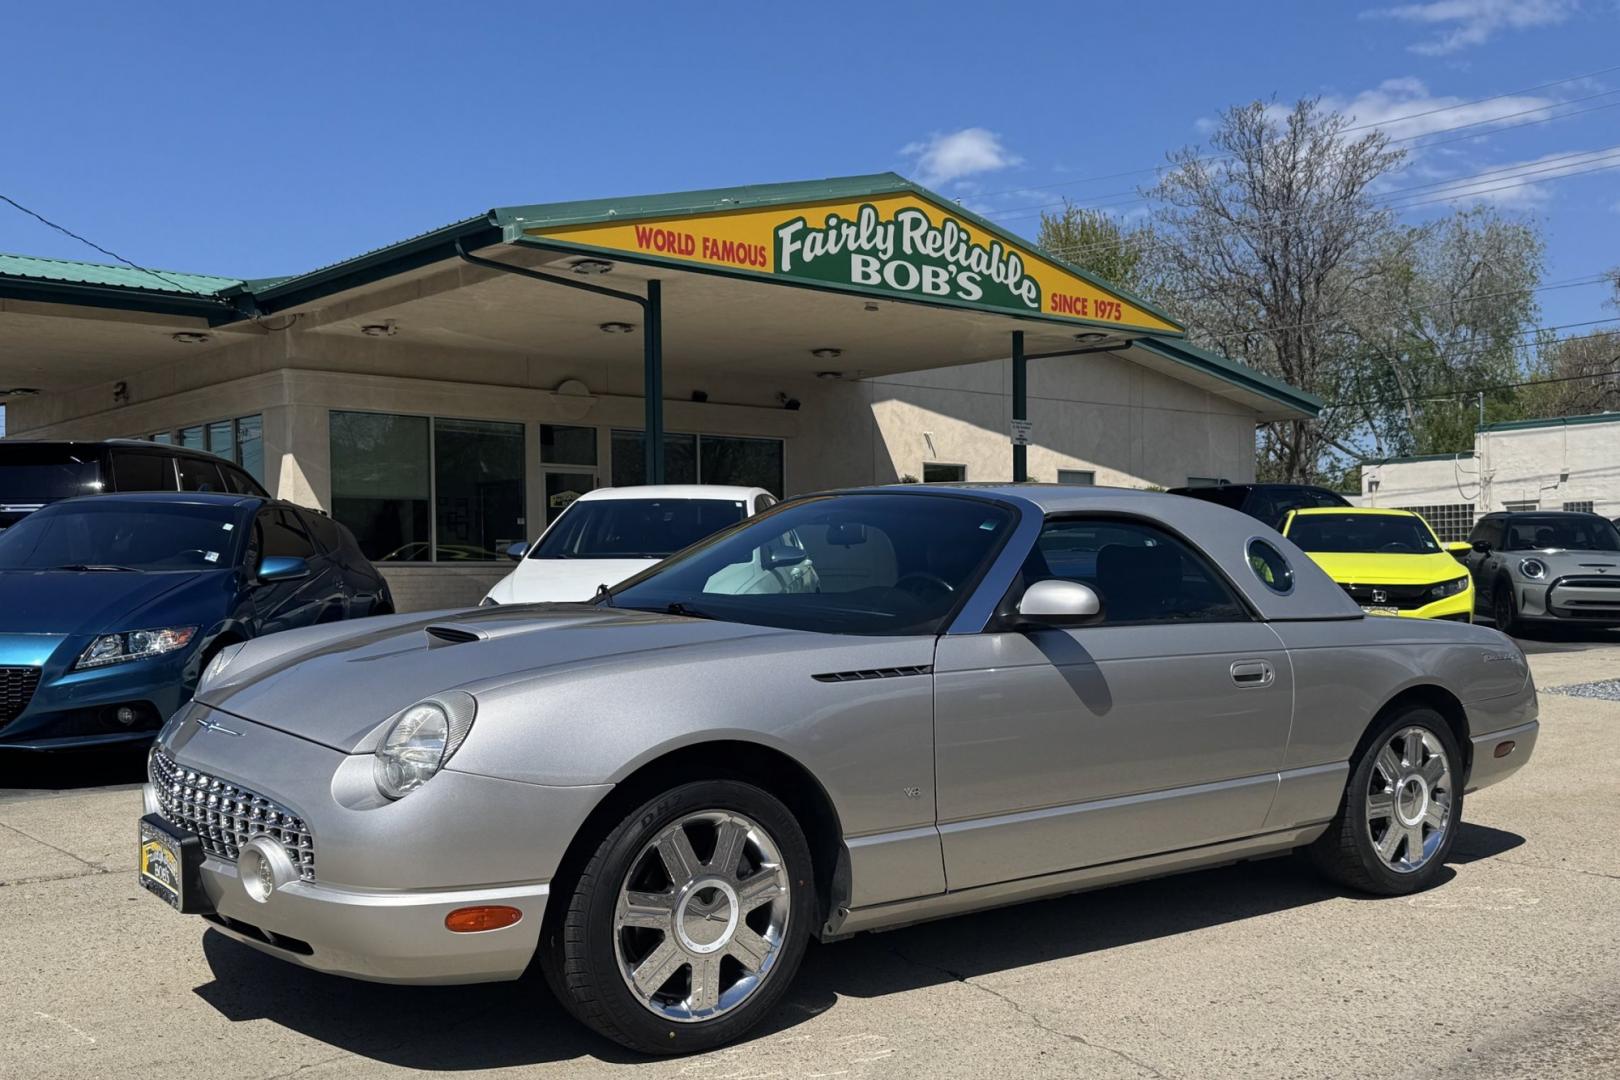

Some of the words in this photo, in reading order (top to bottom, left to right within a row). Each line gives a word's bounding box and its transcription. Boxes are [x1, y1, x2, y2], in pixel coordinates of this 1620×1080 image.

[635, 224, 696, 257] WORLD
[702, 236, 767, 268] FAMOUS
[778, 207, 895, 272] Fairly
[898, 210, 1039, 308] Reliable
[851, 253, 983, 301] BOB'S
[1051, 292, 1088, 317] SINCE
[1094, 299, 1122, 321] 1975
